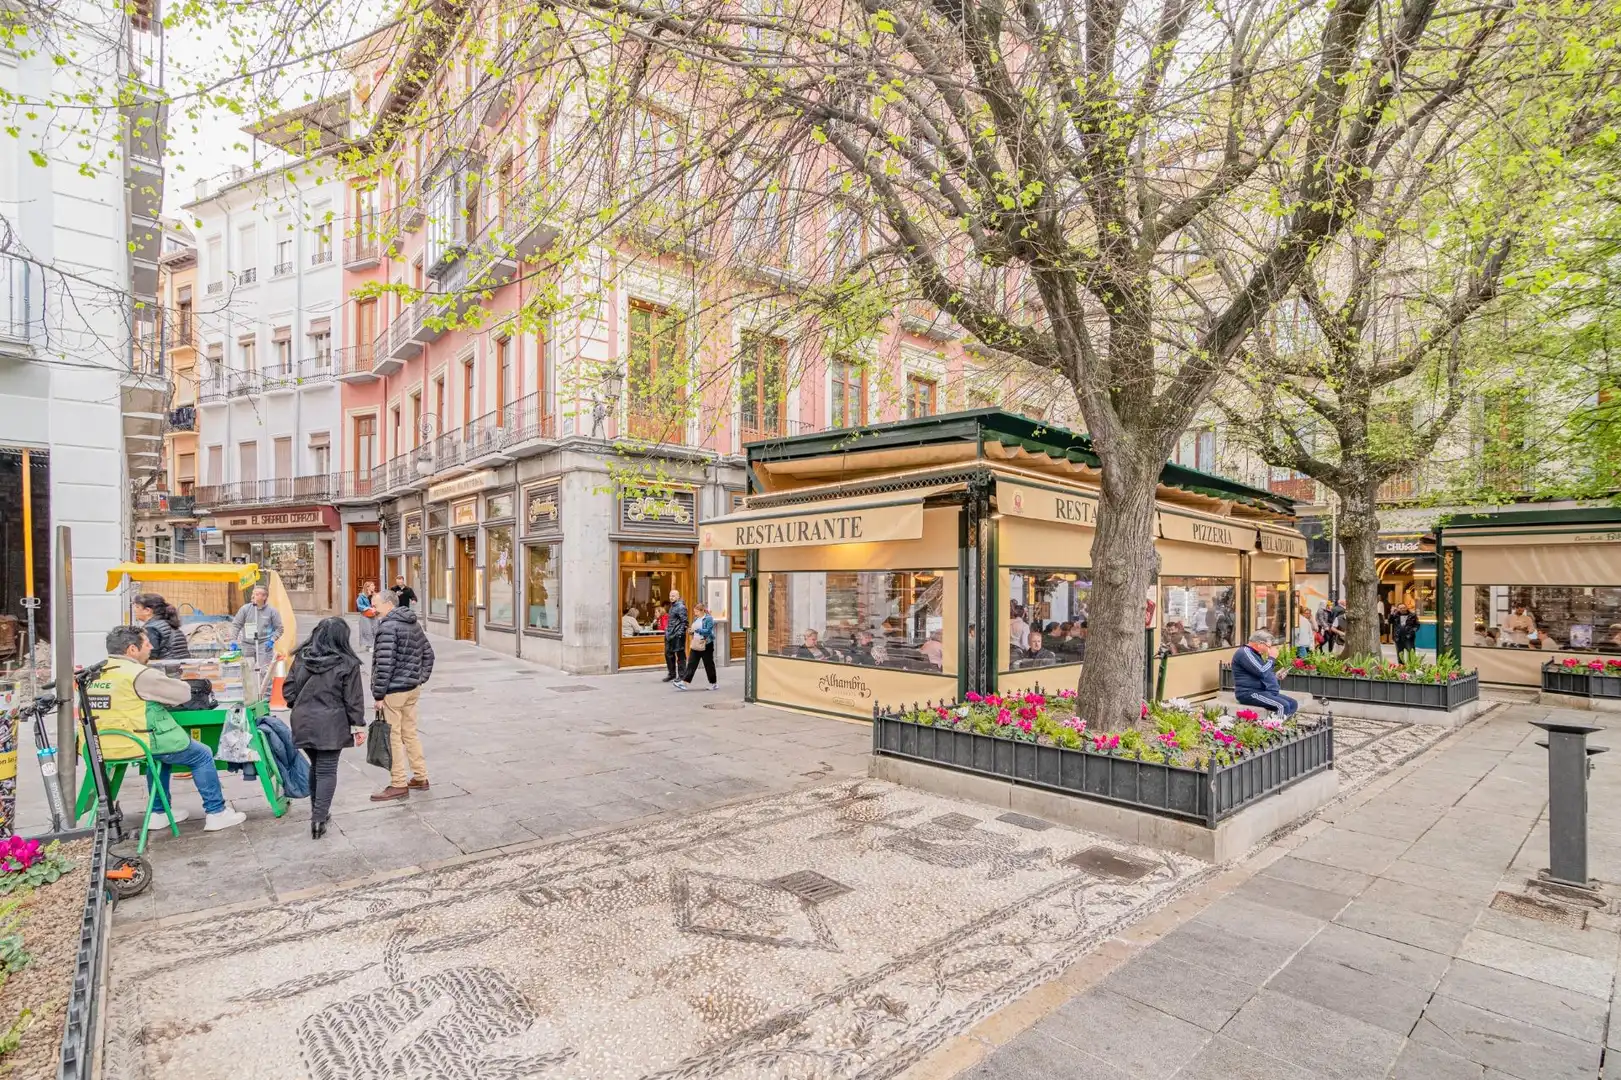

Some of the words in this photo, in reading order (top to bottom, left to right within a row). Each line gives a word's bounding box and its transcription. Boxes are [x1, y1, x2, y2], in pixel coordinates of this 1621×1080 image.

[735, 516, 863, 546] RESTAURANTE
[1193, 523, 1233, 545] PIZZERIA
[819, 673, 871, 698] Alhambra
